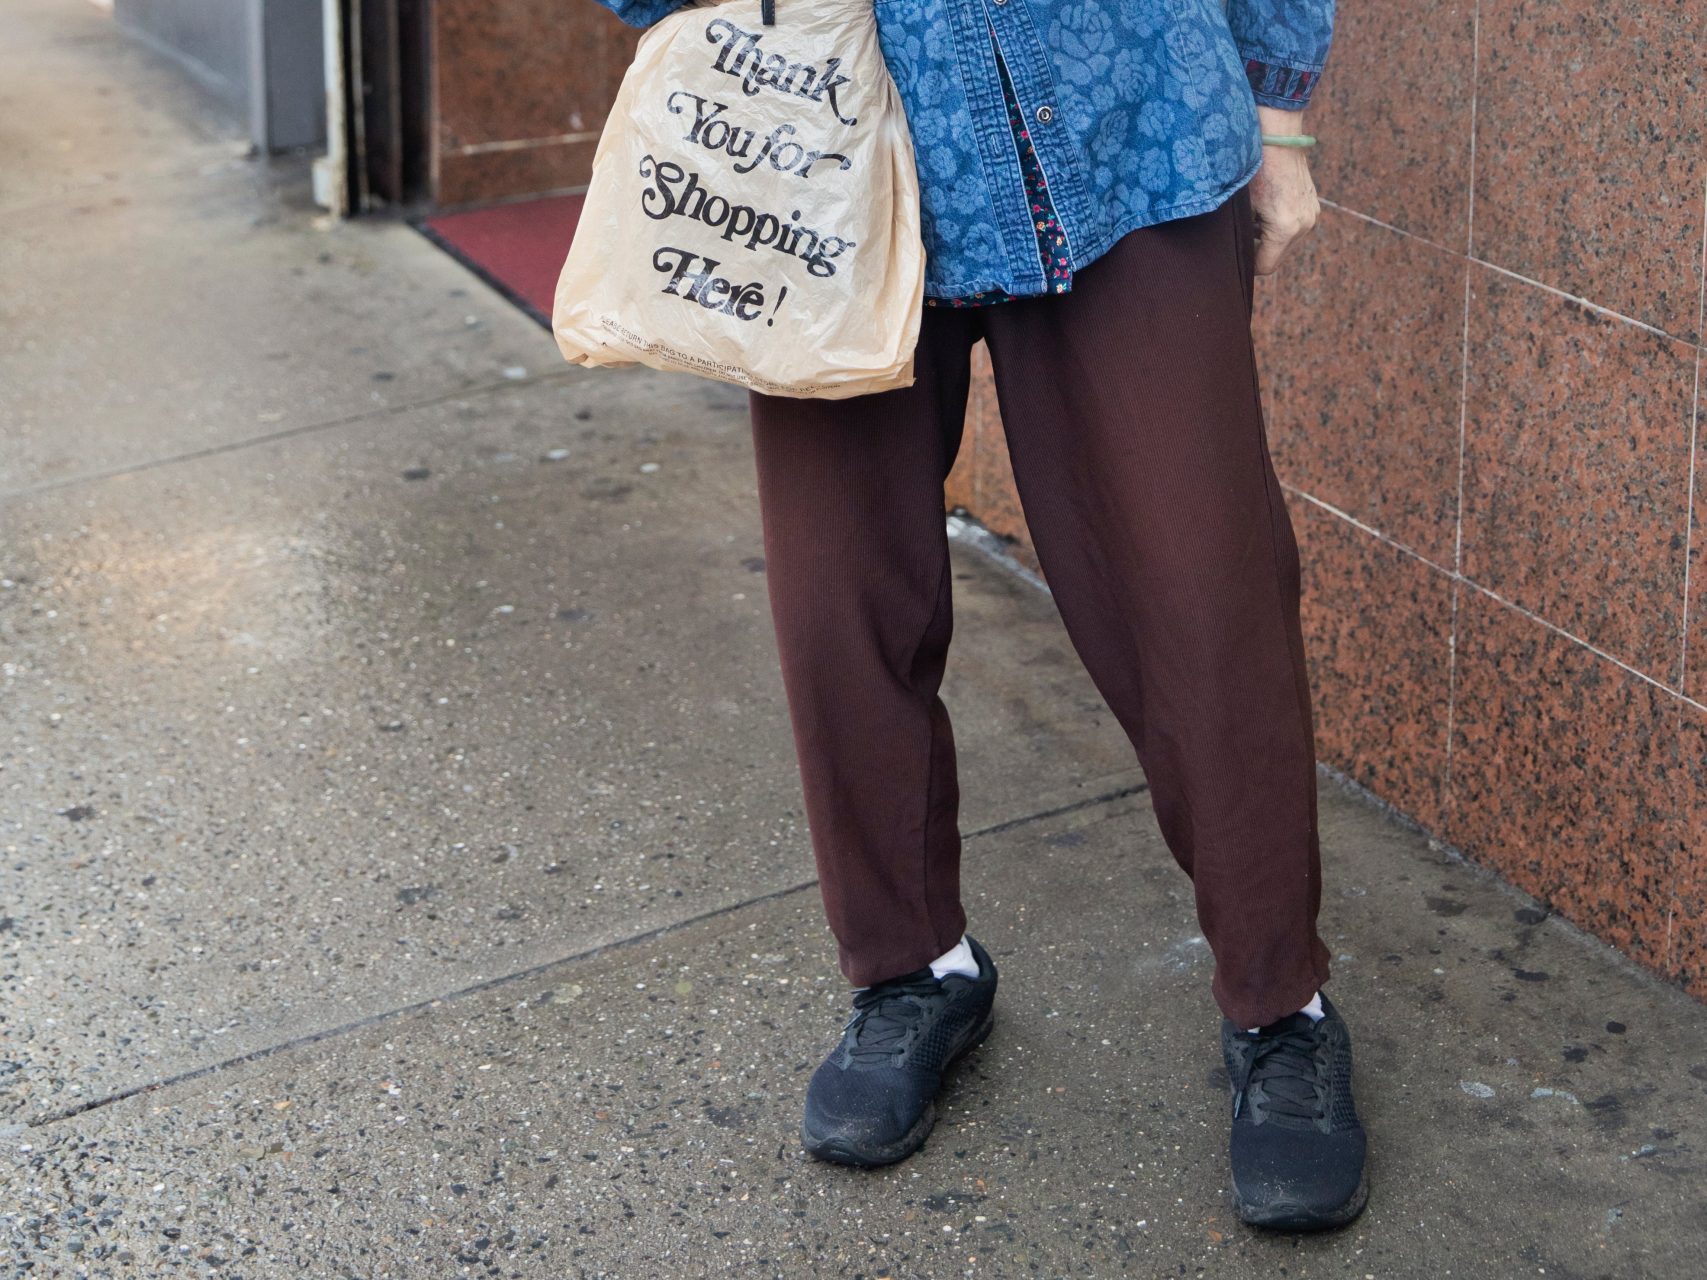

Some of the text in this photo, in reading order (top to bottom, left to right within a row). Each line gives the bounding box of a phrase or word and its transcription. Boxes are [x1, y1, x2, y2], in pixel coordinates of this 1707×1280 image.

[706, 18, 858, 126] Thank
[667, 91, 852, 178] You for
[639, 154, 857, 277] Shopping
[677, 351, 688, 360] TO
[689, 355, 696, 363] A
